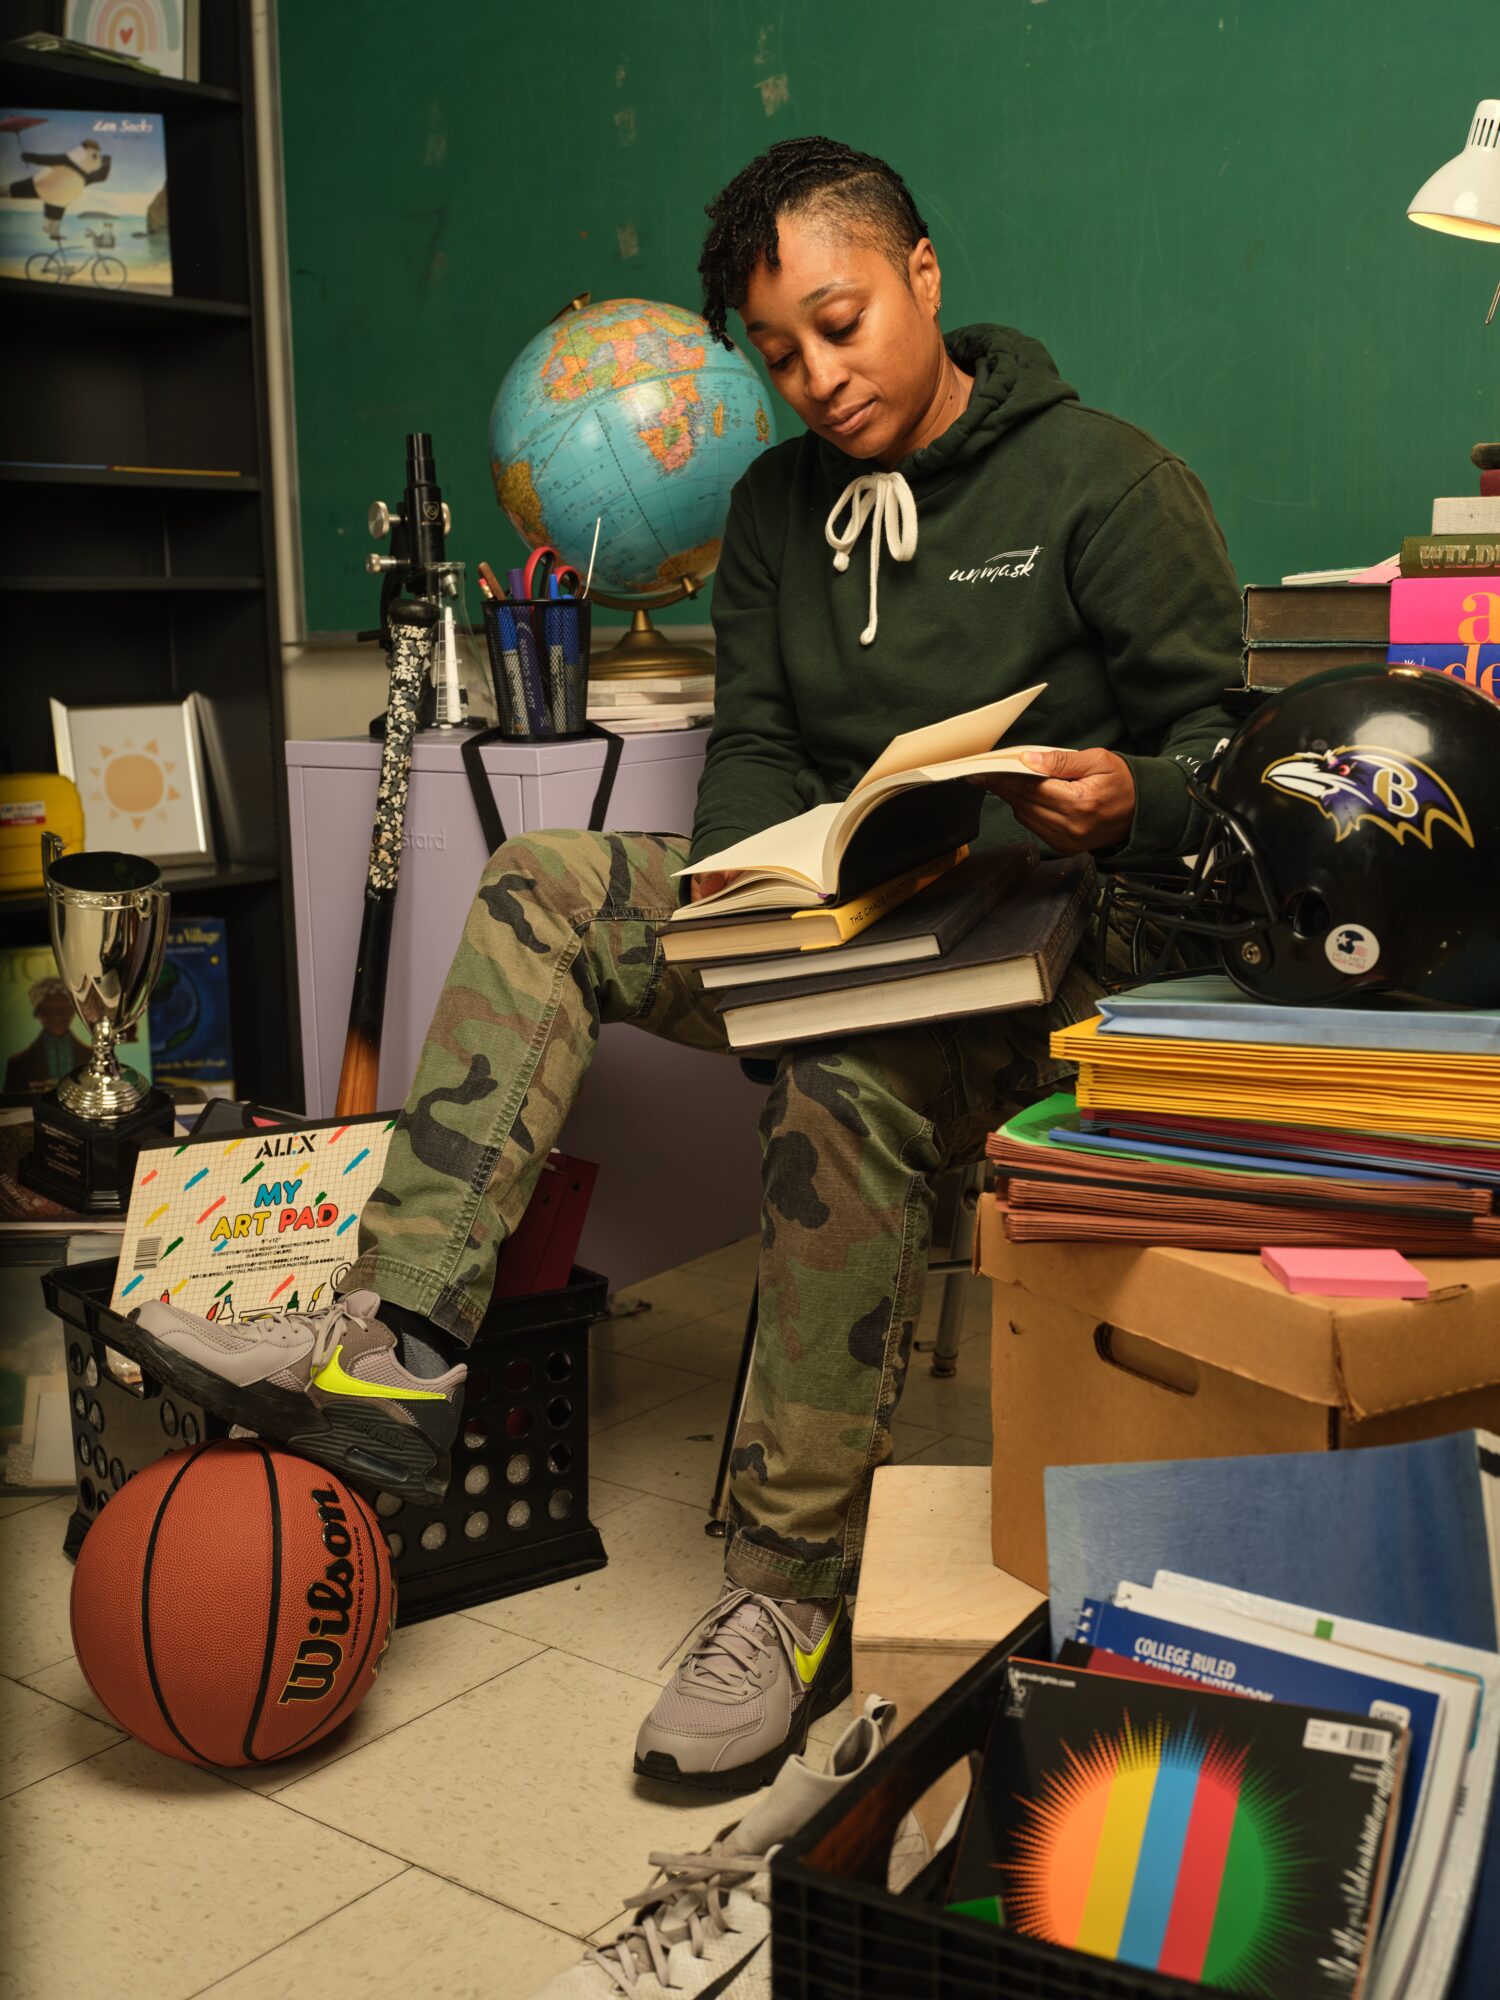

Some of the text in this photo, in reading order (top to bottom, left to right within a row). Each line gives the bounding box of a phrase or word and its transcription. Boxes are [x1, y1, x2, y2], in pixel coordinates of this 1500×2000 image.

[93, 119, 153, 133] Zen Socks
[949, 545, 1044, 583] unmask
[1419, 544, 1500, 569] WILD
[1372, 767, 1420, 818] B
[401, 828, 447, 852] stard
[849, 911, 864, 927] THE
[184, 927, 221, 946] Village
[255, 1133, 316, 1159] ALEX
[254, 1179, 302, 1208] MY
[210, 1203, 338, 1242] ART PAD
[277, 1488, 354, 1704] Wilson
[348, 1525, 366, 1658] COMPOSITE LEATHER
[1134, 1636, 1237, 1680] COLLEGE RULED
